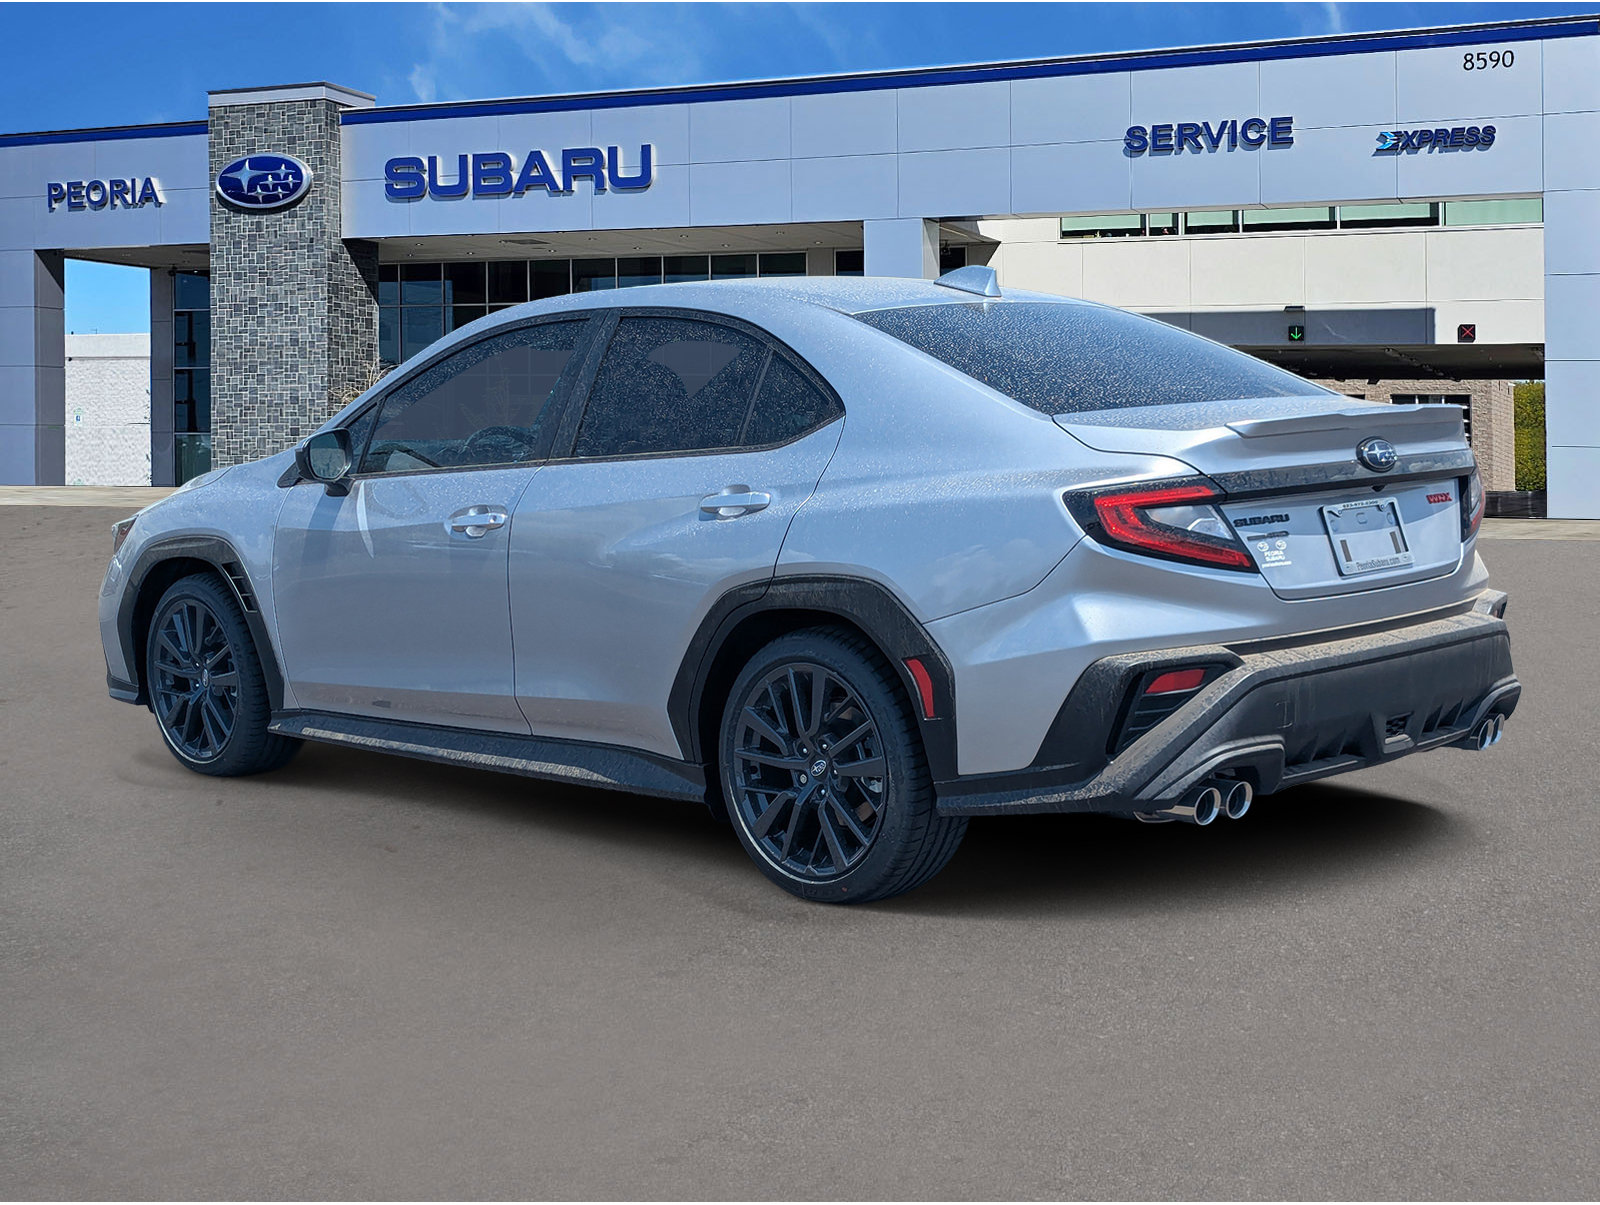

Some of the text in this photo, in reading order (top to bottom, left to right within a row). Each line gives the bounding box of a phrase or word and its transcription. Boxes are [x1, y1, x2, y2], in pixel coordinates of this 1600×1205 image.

[1463, 50, 1514, 71] 8590
[1124, 116, 1294, 153] SERVICE
[1376, 126, 1496, 151] EXPRESS
[384, 144, 653, 201] SUBARU
[48, 177, 161, 211] PEORIA
[1233, 513, 1290, 527] SUBARU
